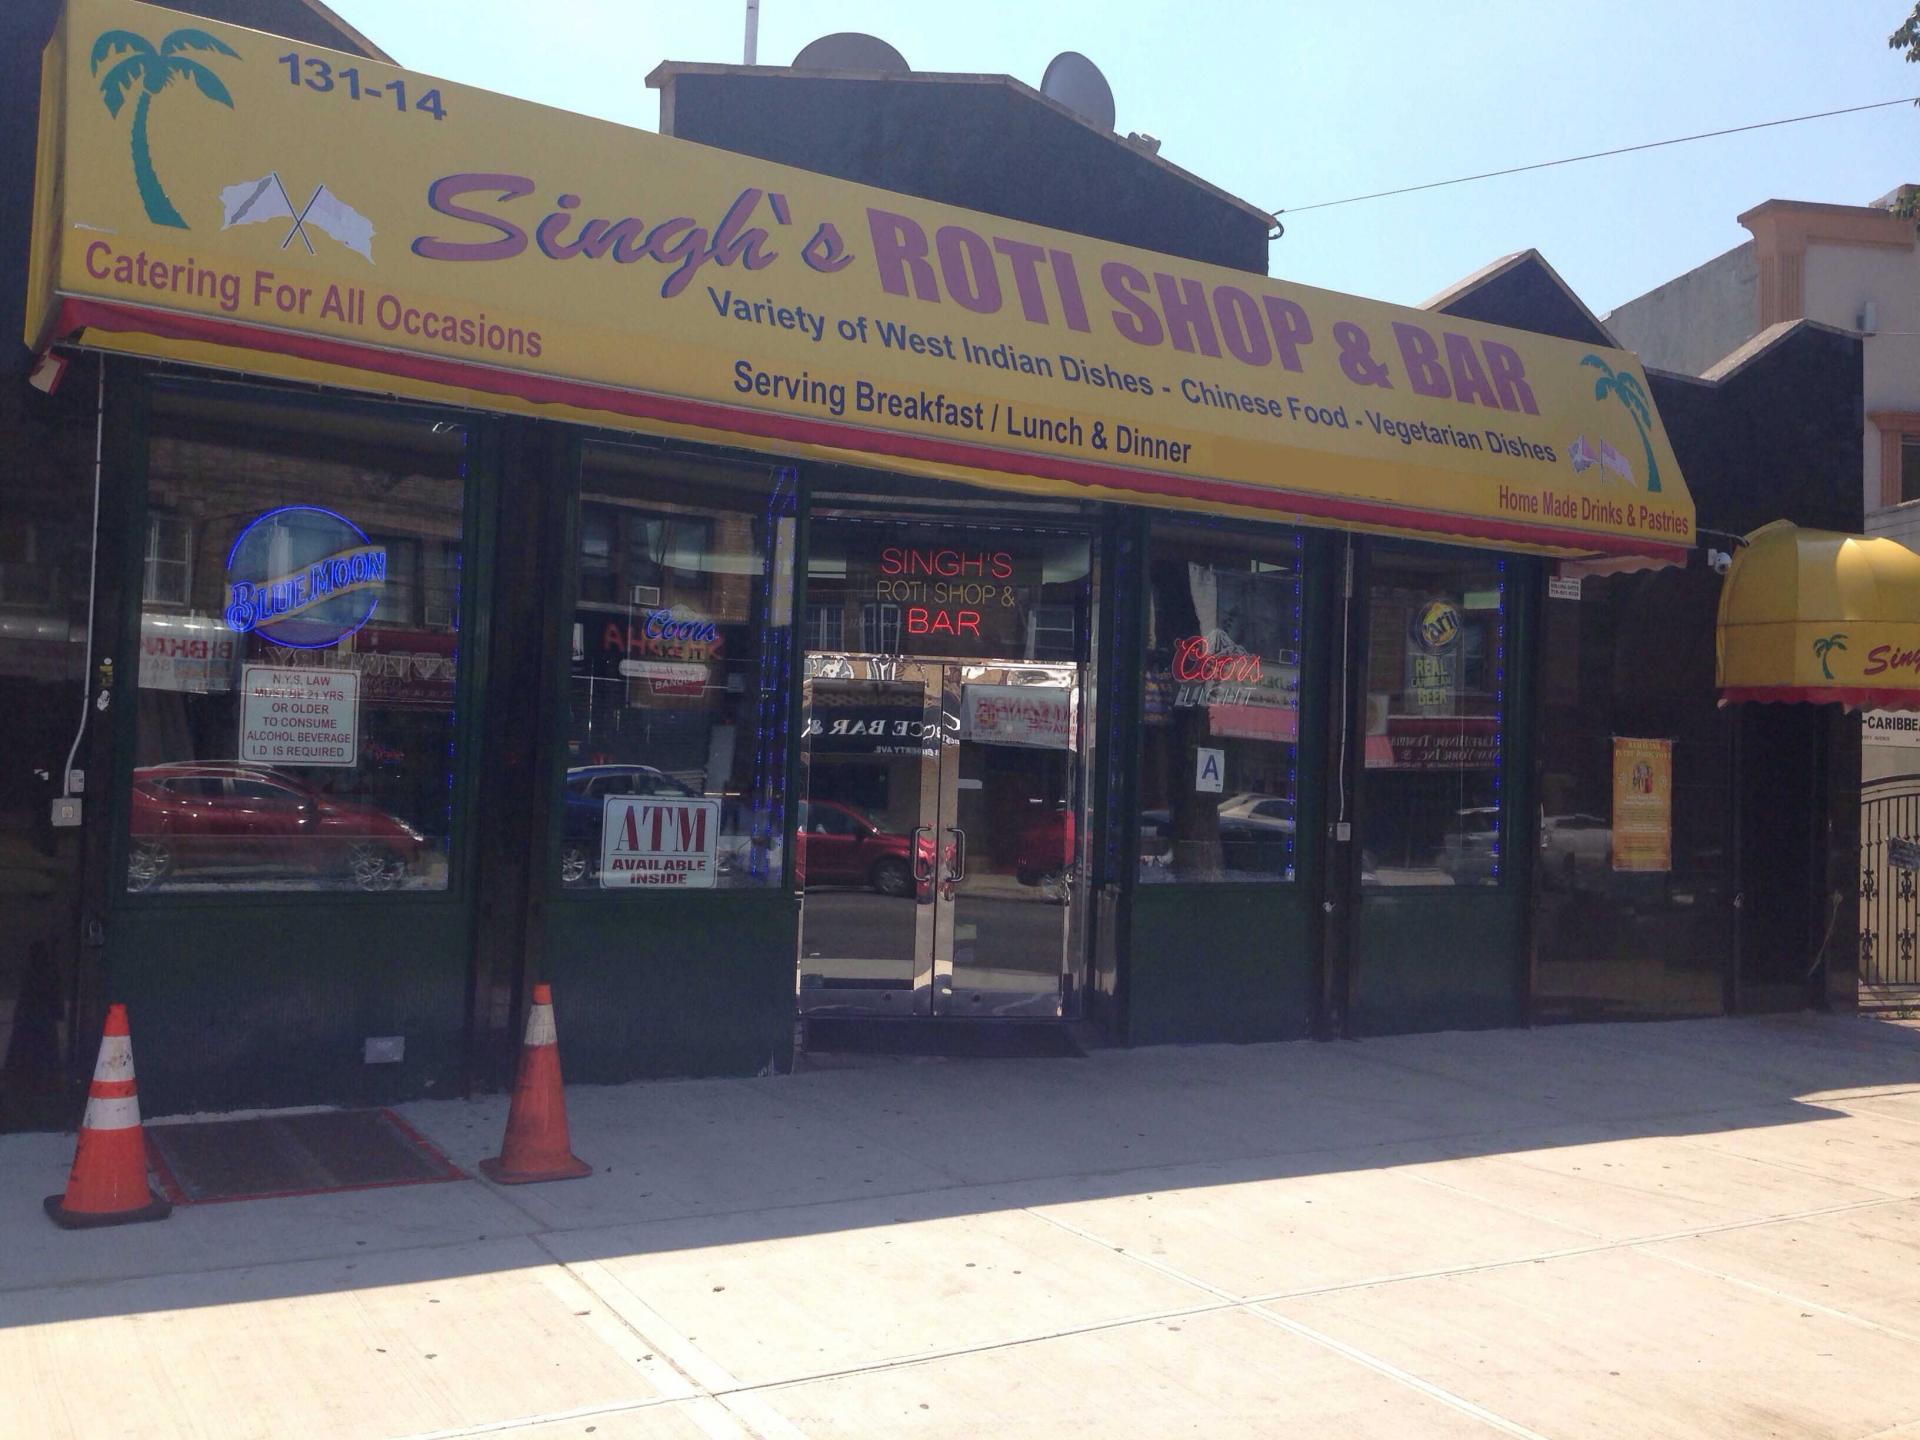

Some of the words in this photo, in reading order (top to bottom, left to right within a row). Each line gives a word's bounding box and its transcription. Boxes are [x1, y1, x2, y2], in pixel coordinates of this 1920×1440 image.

[278, 52, 448, 121] 131-14
[85, 240, 241, 313] Catering
[254, 270, 314, 316] For
[320, 283, 365, 327] All
[377, 294, 543, 358] Occasions
[410, 173, 856, 299] Singh's
[866, 207, 1091, 333] ROTI
[1100, 261, 1315, 373] SHOP
[1333, 320, 1395, 389] &
[1391, 320, 1540, 416] BAR
[707, 286, 826, 342] Variety
[837, 316, 868, 344] of
[876, 320, 957, 361] West
[963, 337, 1053, 378] Indian
[1062, 355, 1154, 396] Dishes
[1181, 377, 1283, 419] Chinese
[1286, 396, 1348, 430] Food
[1365, 410, 1483, 452] Vegetarian
[1485, 430, 1557, 463] Dishes
[734, 360, 845, 415] Serving
[856, 380, 985, 431] Breakfast
[991, 403, 999, 433] /
[1007, 406, 1083, 446] Lunch
[1091, 420, 1109, 451] &
[1116, 426, 1192, 464] Dinner
[1499, 484, 1539, 515] Home
[1543, 491, 1578, 519] Made
[1582, 496, 1623, 526] Drinks
[1626, 503, 1637, 527] &
[1639, 505, 1689, 535] Pastries
[880, 547, 1013, 578] SINGH'S
[226, 574, 306, 633] BLUE
[310, 552, 387, 597] MOON
[877, 580, 927, 603] ROTI
[935, 582, 996, 605] SHOP
[1001, 585, 1016, 608] &
[643, 608, 720, 642] Coors
[908, 607, 982, 637] BAR
[1171, 635, 1265, 683] Coors
[1415, 658, 1446, 677] REAL
[254, 688, 285, 698] MUST
[289, 689, 304, 699] BE
[306, 690, 319, 700] 21
[322, 691, 344, 701] YRS
[306, 675, 331, 686] LAW
[271, 703, 288, 713] OR
[291, 703, 329, 714] OLDER
[1174, 686, 1257, 707] LIGHT
[246, 731, 297, 742] ALCOHOL
[297, 732, 352, 743] BEVERAGE
[262, 717, 278, 727] TO
[280, 718, 337, 729] CONSUME
[1862, 716, 1920, 731] -CARIBBE
[273, 746, 284, 756] IS
[286, 747, 345, 758] REQUIRED
[1201, 754, 1219, 781] A
[614, 806, 707, 853] ATM
[612, 858, 706, 872] AVAILABLE
[630, 872, 687, 885] INSIDE
